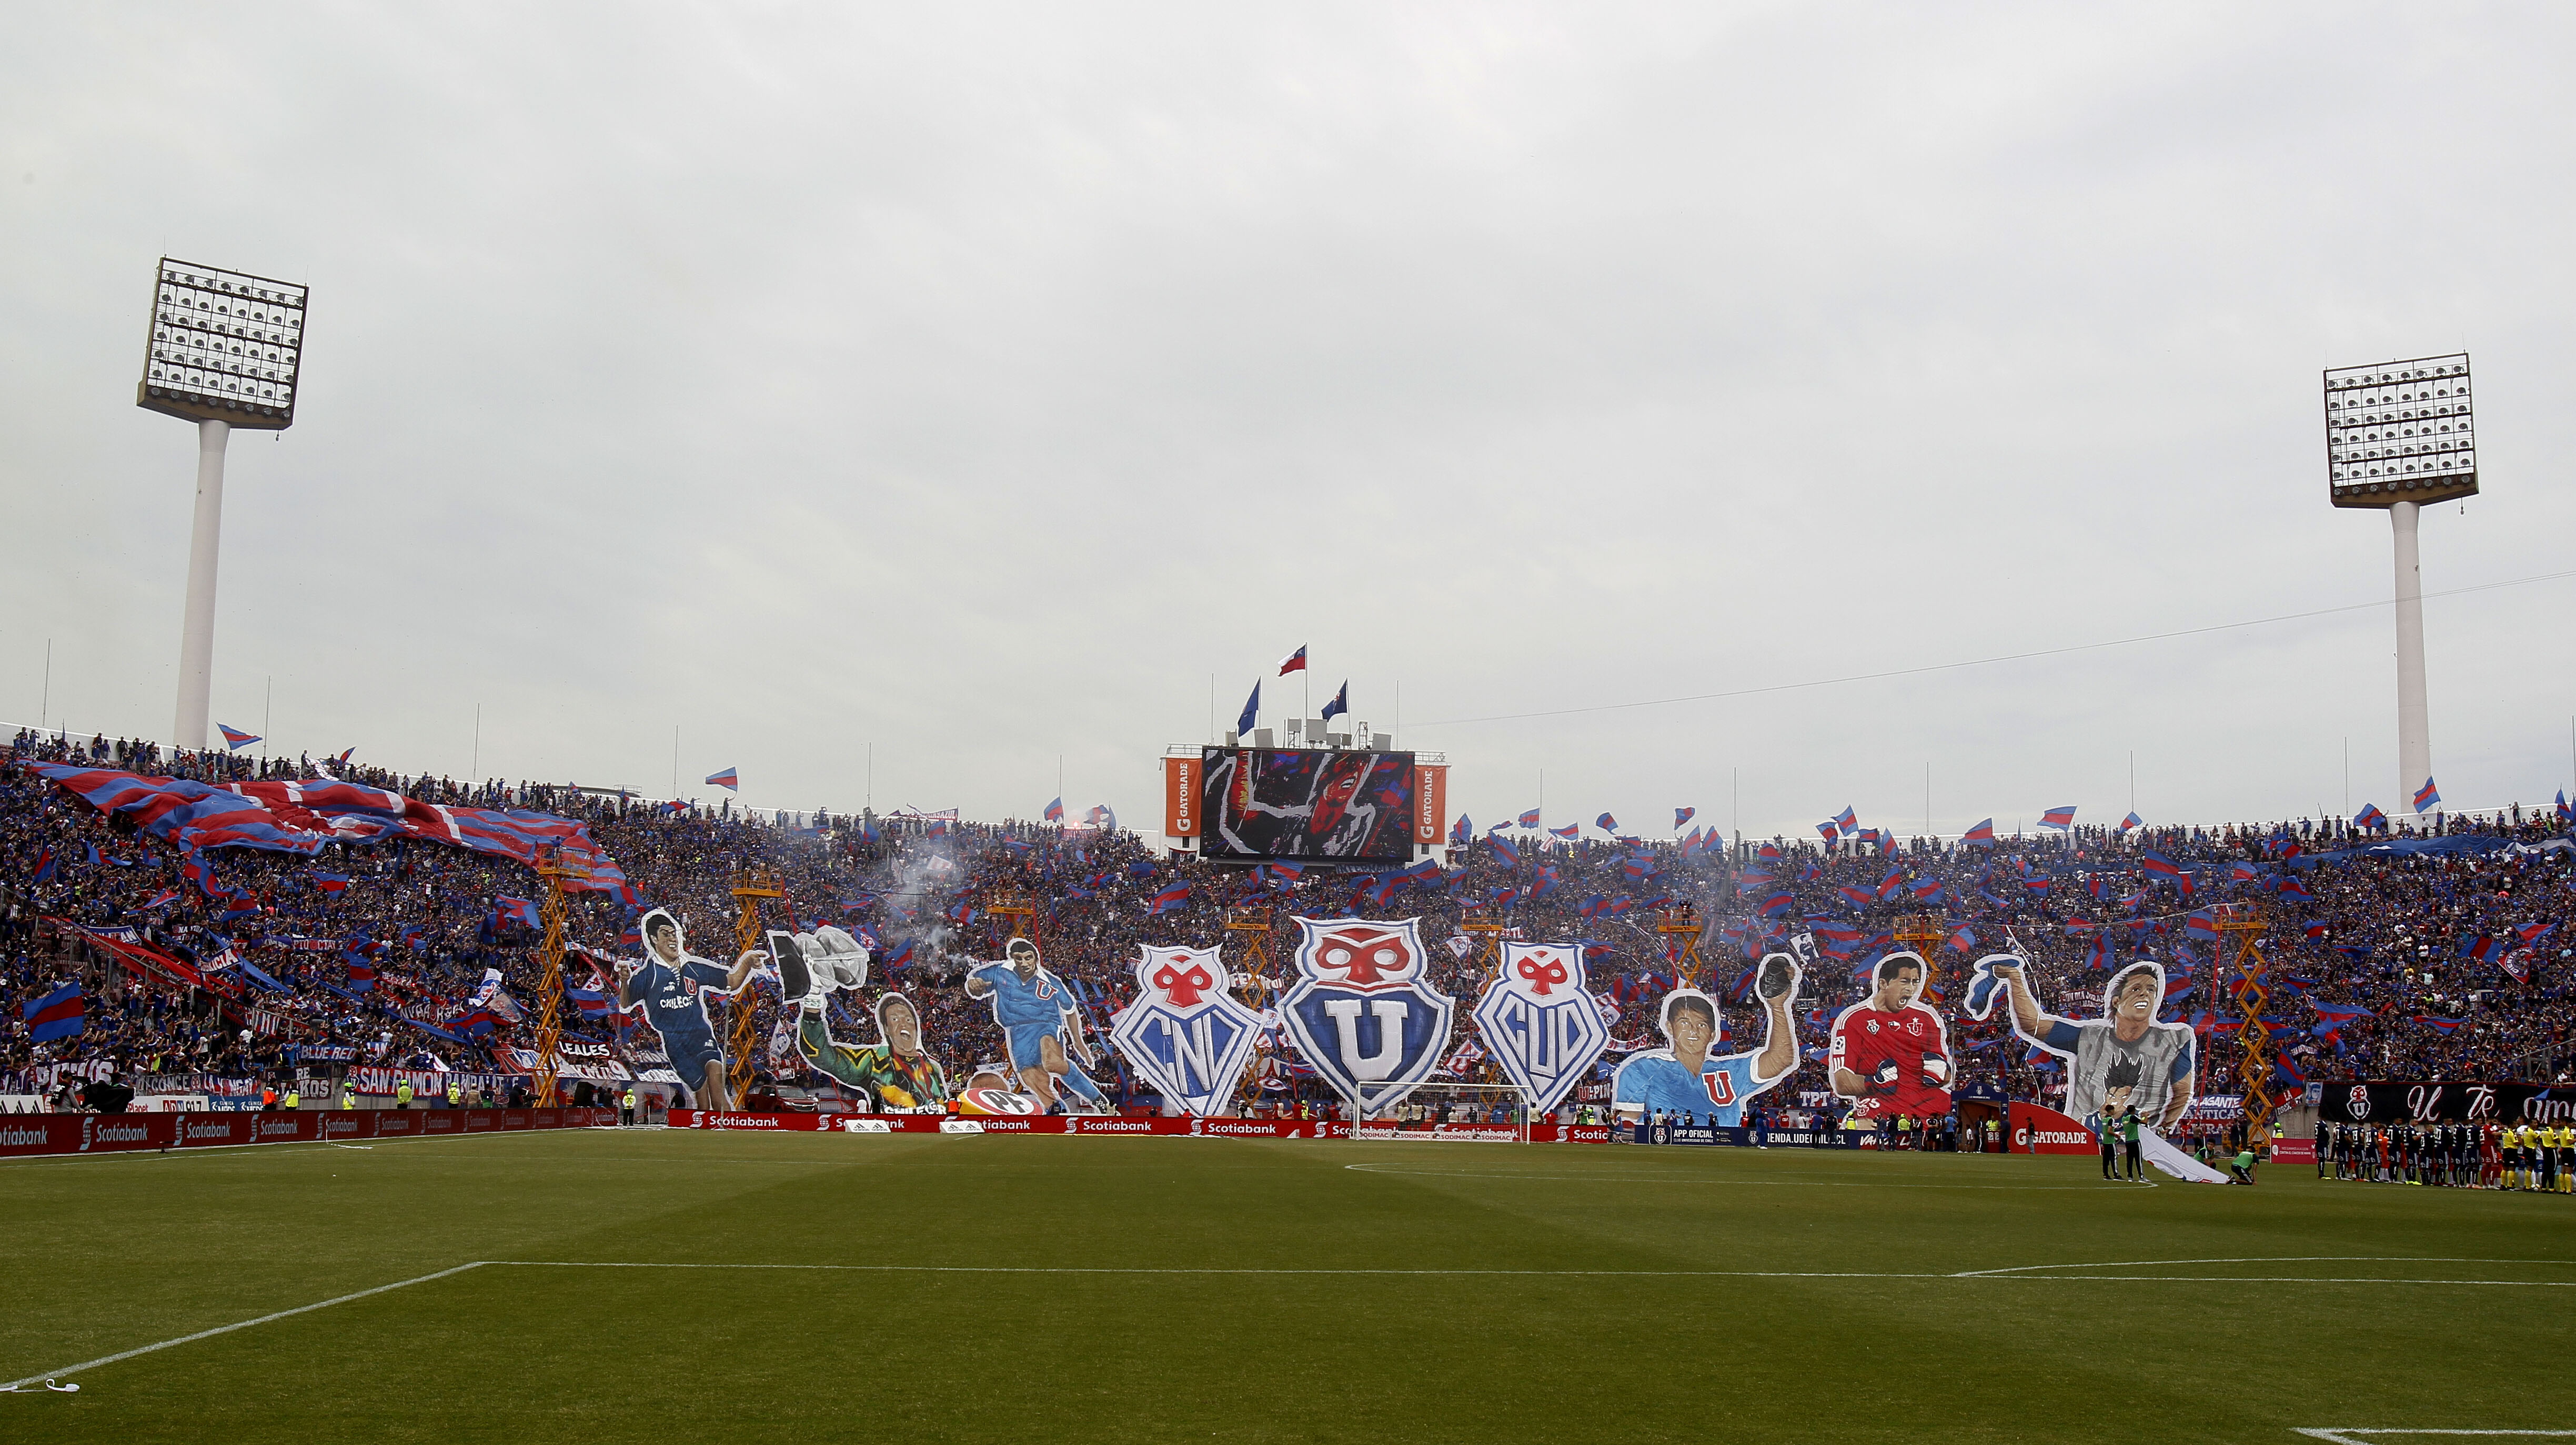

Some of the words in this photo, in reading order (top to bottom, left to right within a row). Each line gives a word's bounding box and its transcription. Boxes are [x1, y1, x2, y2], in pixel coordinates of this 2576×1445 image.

[1424, 770, 1433, 825] GATORADE
[683, 976, 698, 996] U
[1034, 979, 1059, 1000] U
[558, 1040, 610, 1056] LEALES
[1324, 999, 1408, 1081] U
[301, 1045, 330, 1059] BLUE
[331, 1047, 358, 1060] RED
[296, 1066, 310, 1080] RE
[360, 1067, 390, 1093] SAN
[1702, 1070, 1738, 1106] U
[984, 1090, 1026, 1113] PF
[1799, 1091, 1830, 1107] TPT
[2408, 1085, 2442, 1122] U
[260, 1118, 298, 1135] Scotiabank
[326, 1117, 358, 1132] Scotiabank
[381, 1115, 409, 1130] Scotiabank
[428, 1115, 452, 1129] Scotiabank
[469, 1115, 490, 1127] Scotiabank
[709, 1116, 779, 1127] Scotiabank
[1083, 1120, 1152, 1131] Scotiabank
[1208, 1123, 1276, 1133] Scotiabank
[96, 1122, 148, 1143] Scotiabank
[187, 1120, 231, 1139] Scotiabank
[1689, 1130, 1714, 1138] OFICIAL
[2034, 1131, 2087, 1144] GATORADE
